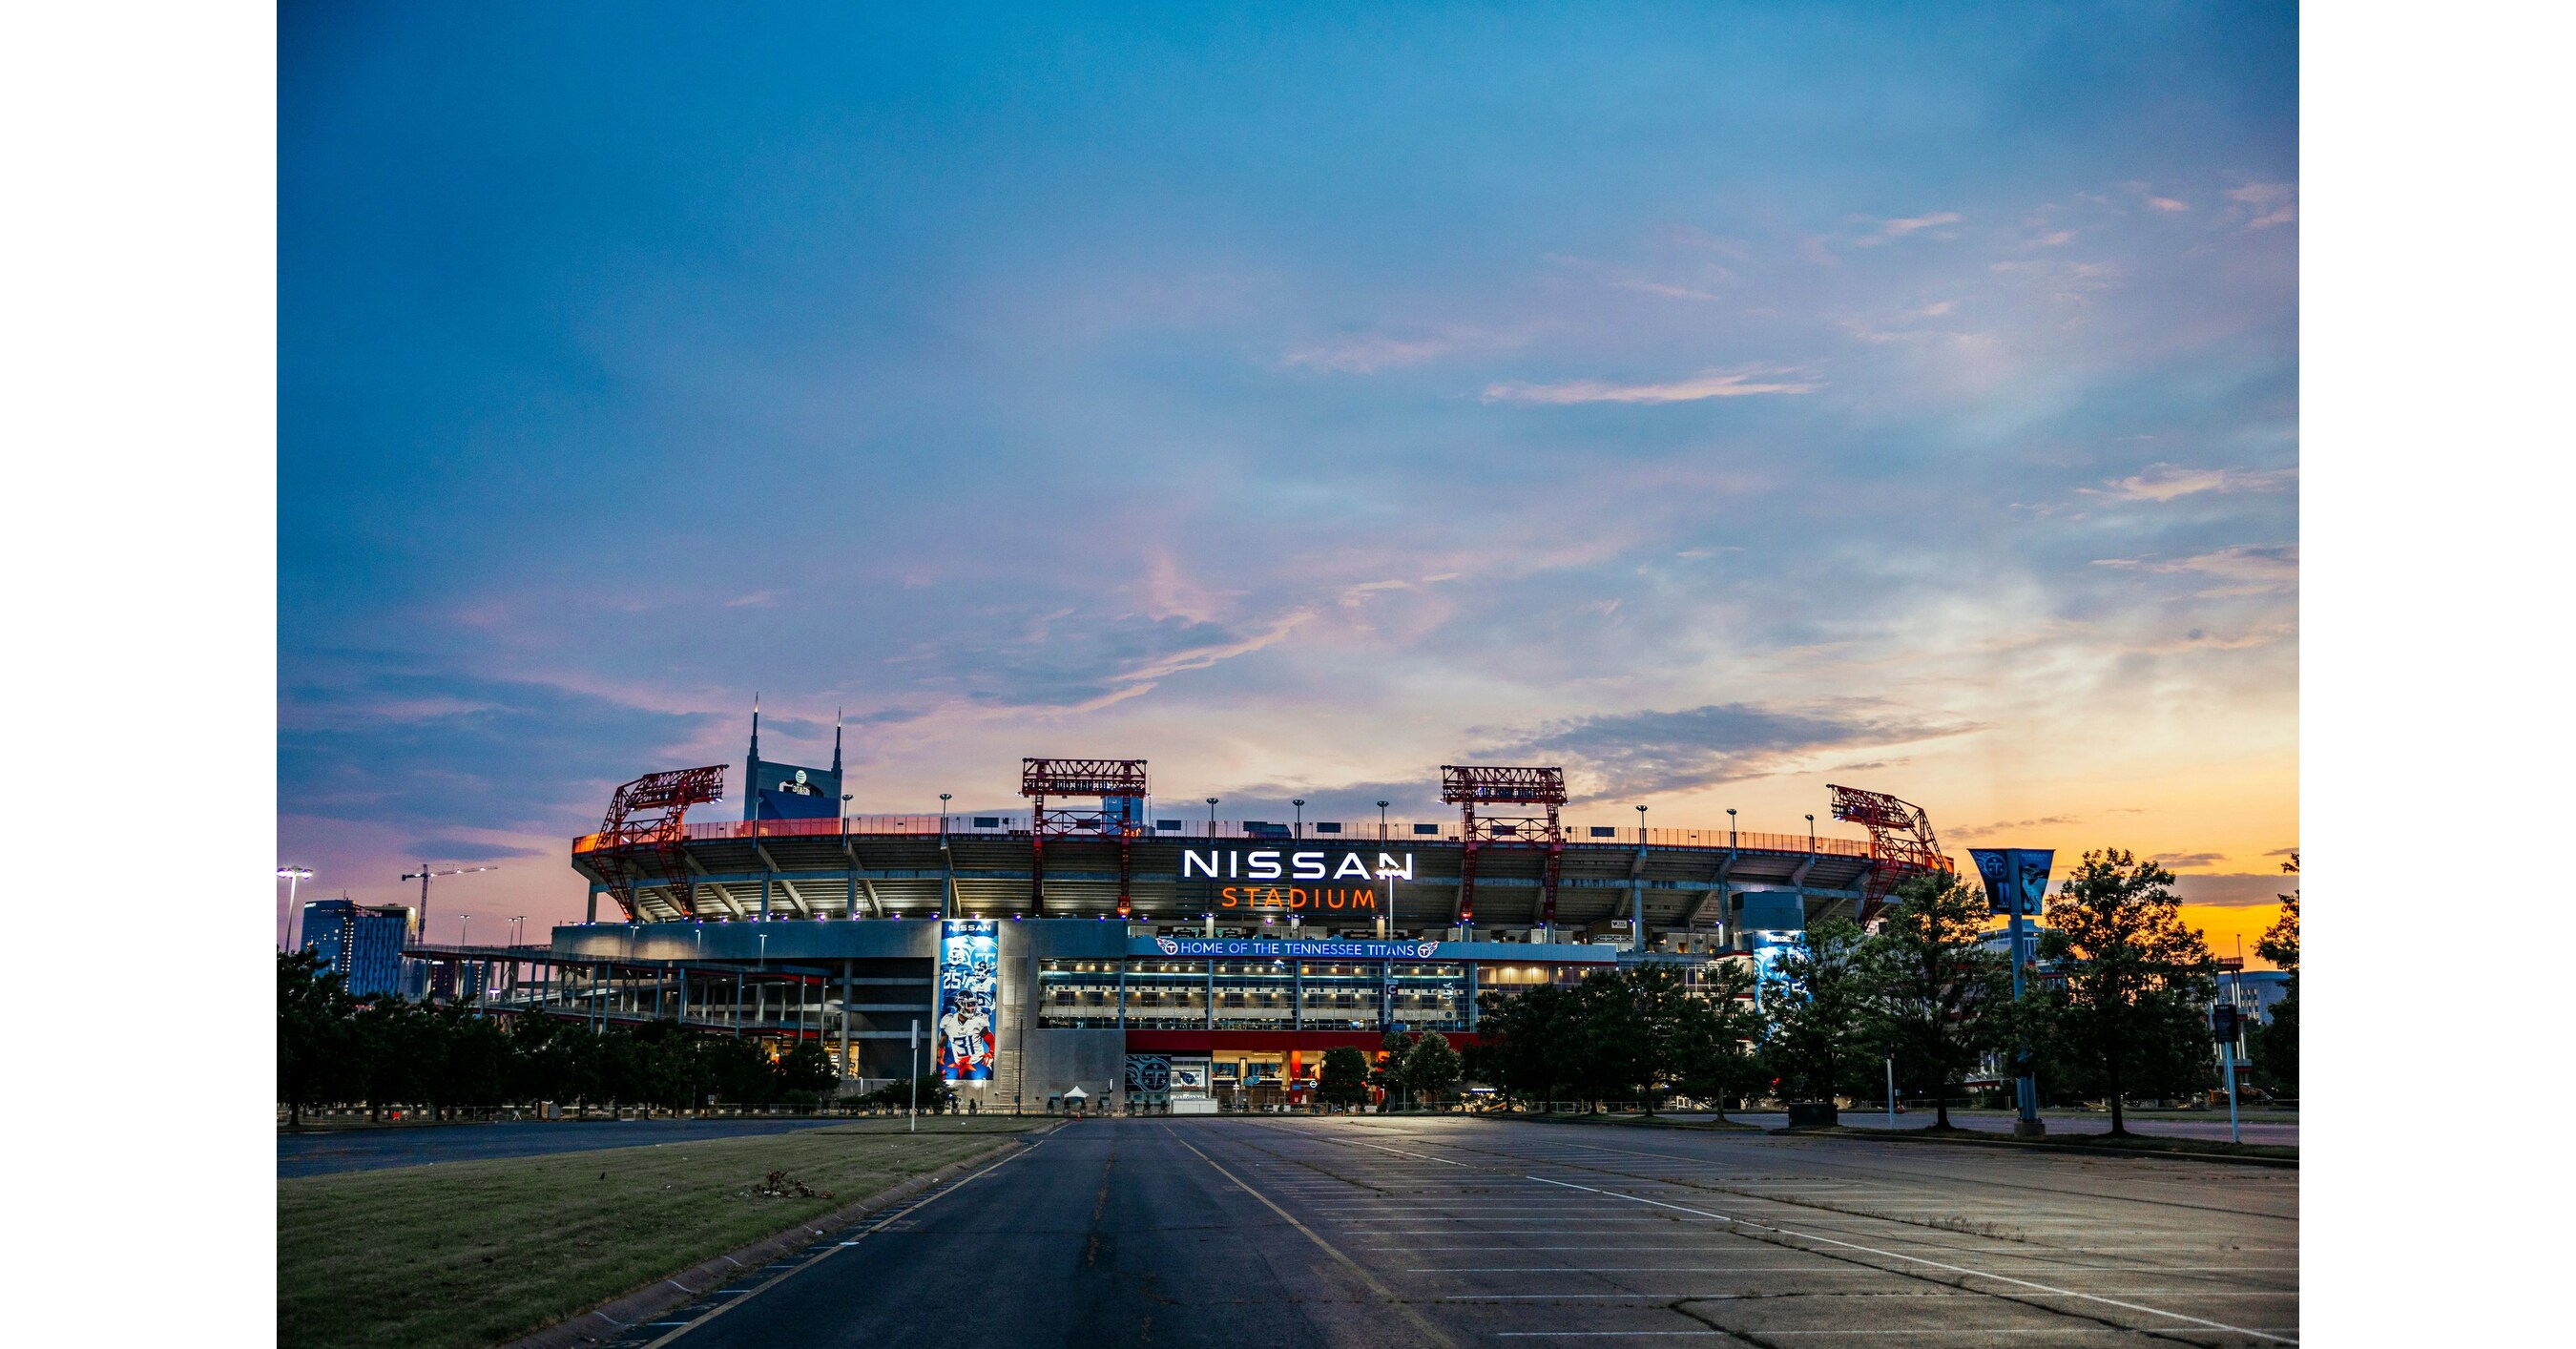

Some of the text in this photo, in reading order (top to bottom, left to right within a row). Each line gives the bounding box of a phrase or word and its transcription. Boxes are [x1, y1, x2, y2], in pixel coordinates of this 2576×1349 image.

[1183, 850, 1413, 881] NISSAN
[1221, 887, 1376, 909] STADIUM
[1181, 942, 1415, 956] HOME OF THE TENNESSEE TITANS
[944, 972, 962, 989] 25
[954, 1035, 976, 1057] 31
